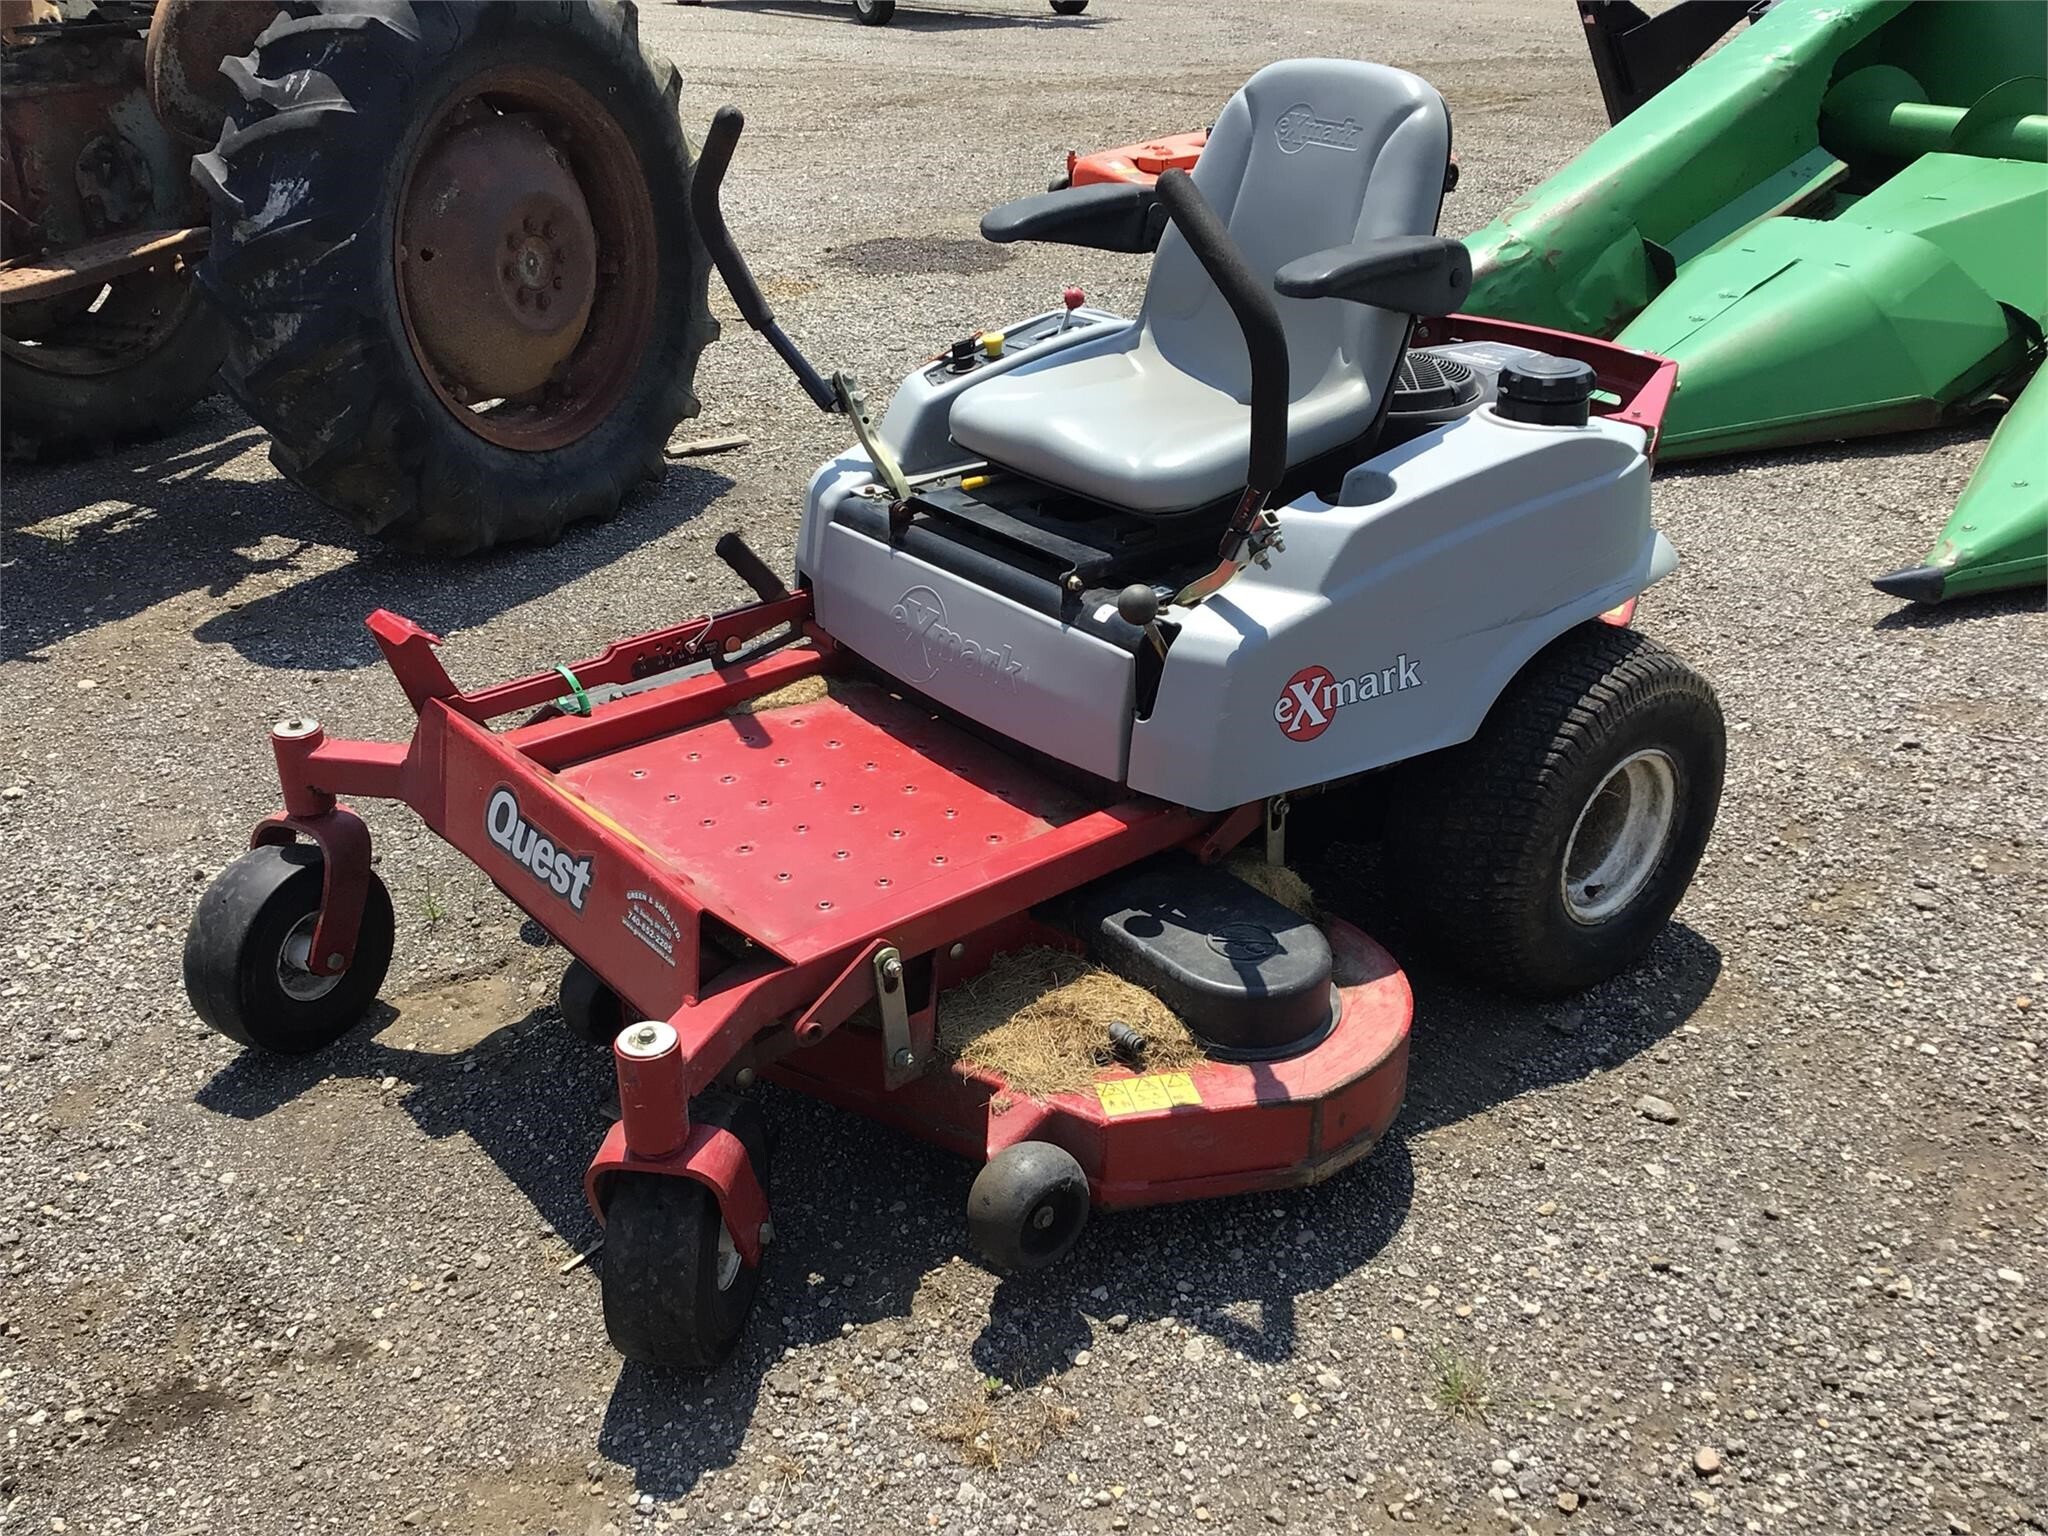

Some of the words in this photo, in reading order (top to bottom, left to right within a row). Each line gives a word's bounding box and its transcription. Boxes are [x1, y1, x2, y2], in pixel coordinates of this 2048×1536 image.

[1274, 654, 1421, 733] eXmark
[487, 791, 591, 910] Quest
[626, 891, 648, 901] GREEN
[648, 896, 654, 904] &
